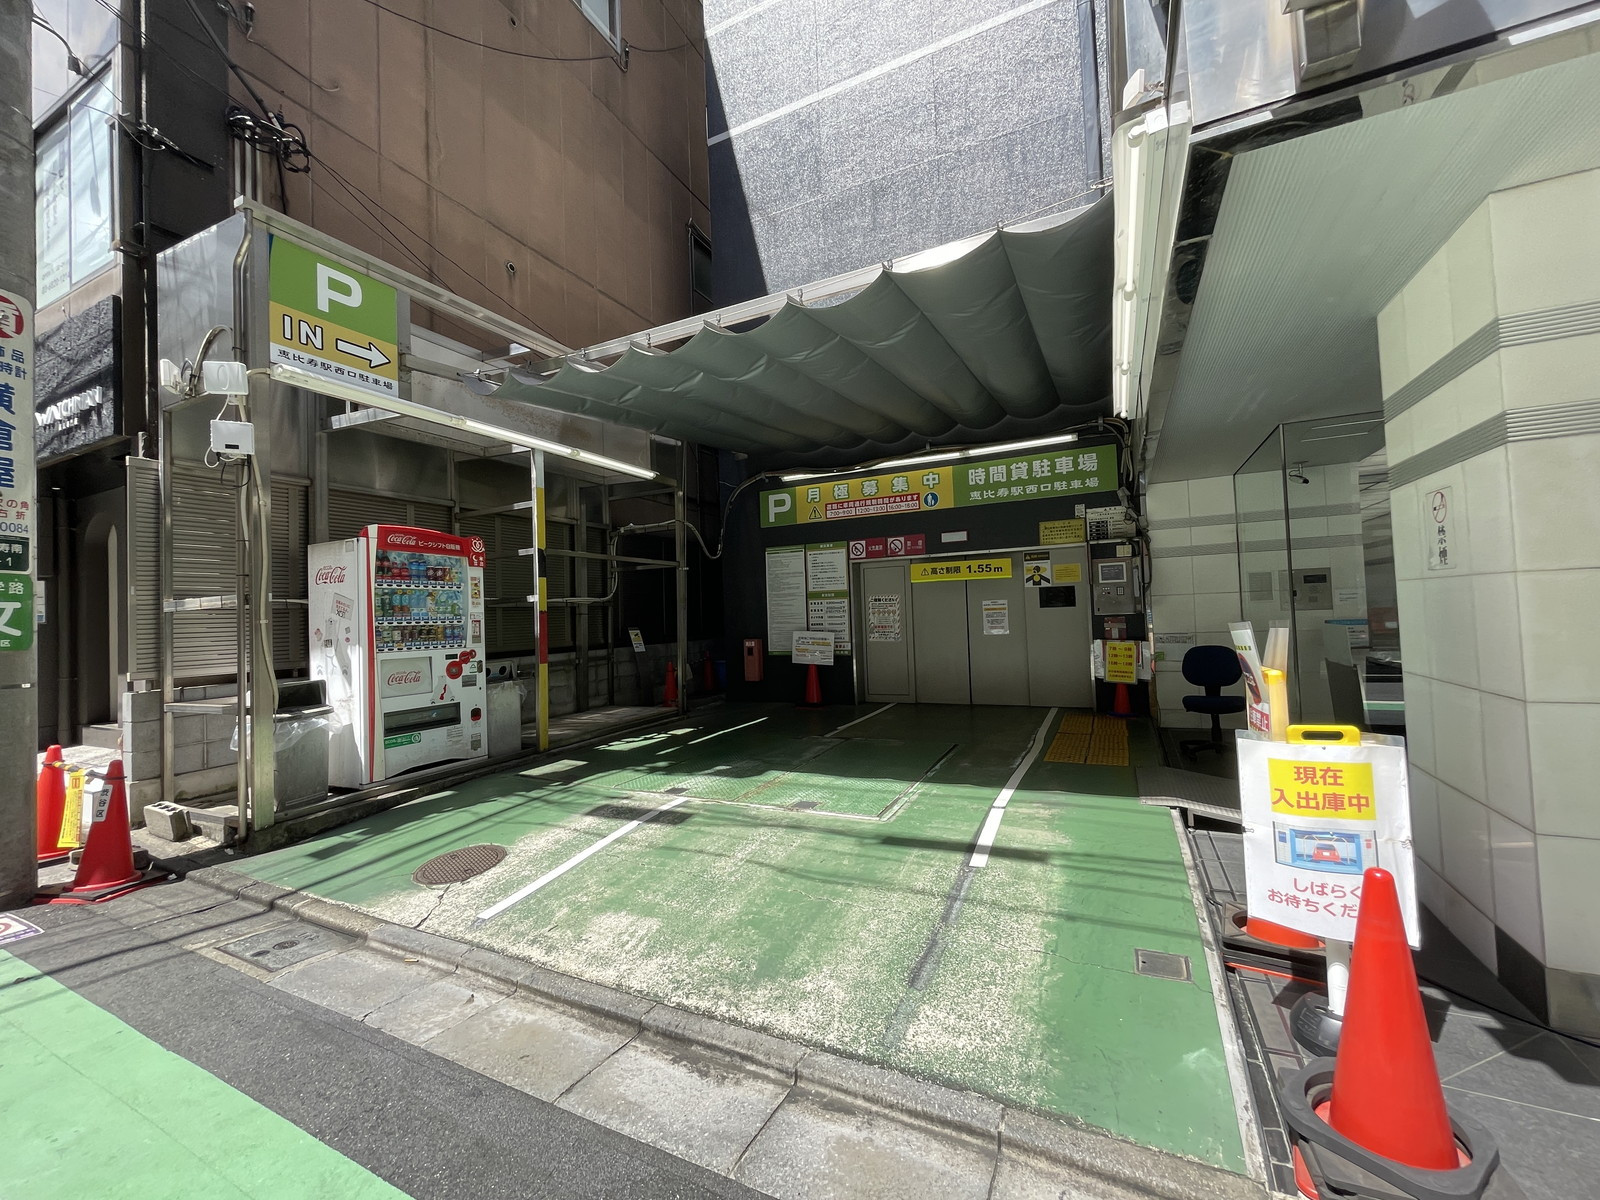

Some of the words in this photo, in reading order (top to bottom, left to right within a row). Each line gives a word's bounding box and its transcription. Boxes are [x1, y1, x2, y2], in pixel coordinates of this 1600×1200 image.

[316, 262, 363, 312] P
[282, 315, 324, 350] IN
[277, 348, 394, 391] 恵比寿駅西口駐車場
[967, 453, 1099, 486] 時間貸駐車場
[806, 472, 940, 503] 月極募集中
[968, 477, 1100, 501] 恵比寿駅西口駐車場
[768, 493, 792, 522] P
[930, 564, 962, 576] 高さ制限
[966, 563, 1003, 575] 1.55m
[1293, 766, 1345, 787] 現在
[96, 788, 110, 818] 渋谷区
[1271, 788, 1371, 813] 入出庫中
[1293, 877, 1361, 900] しばらく
